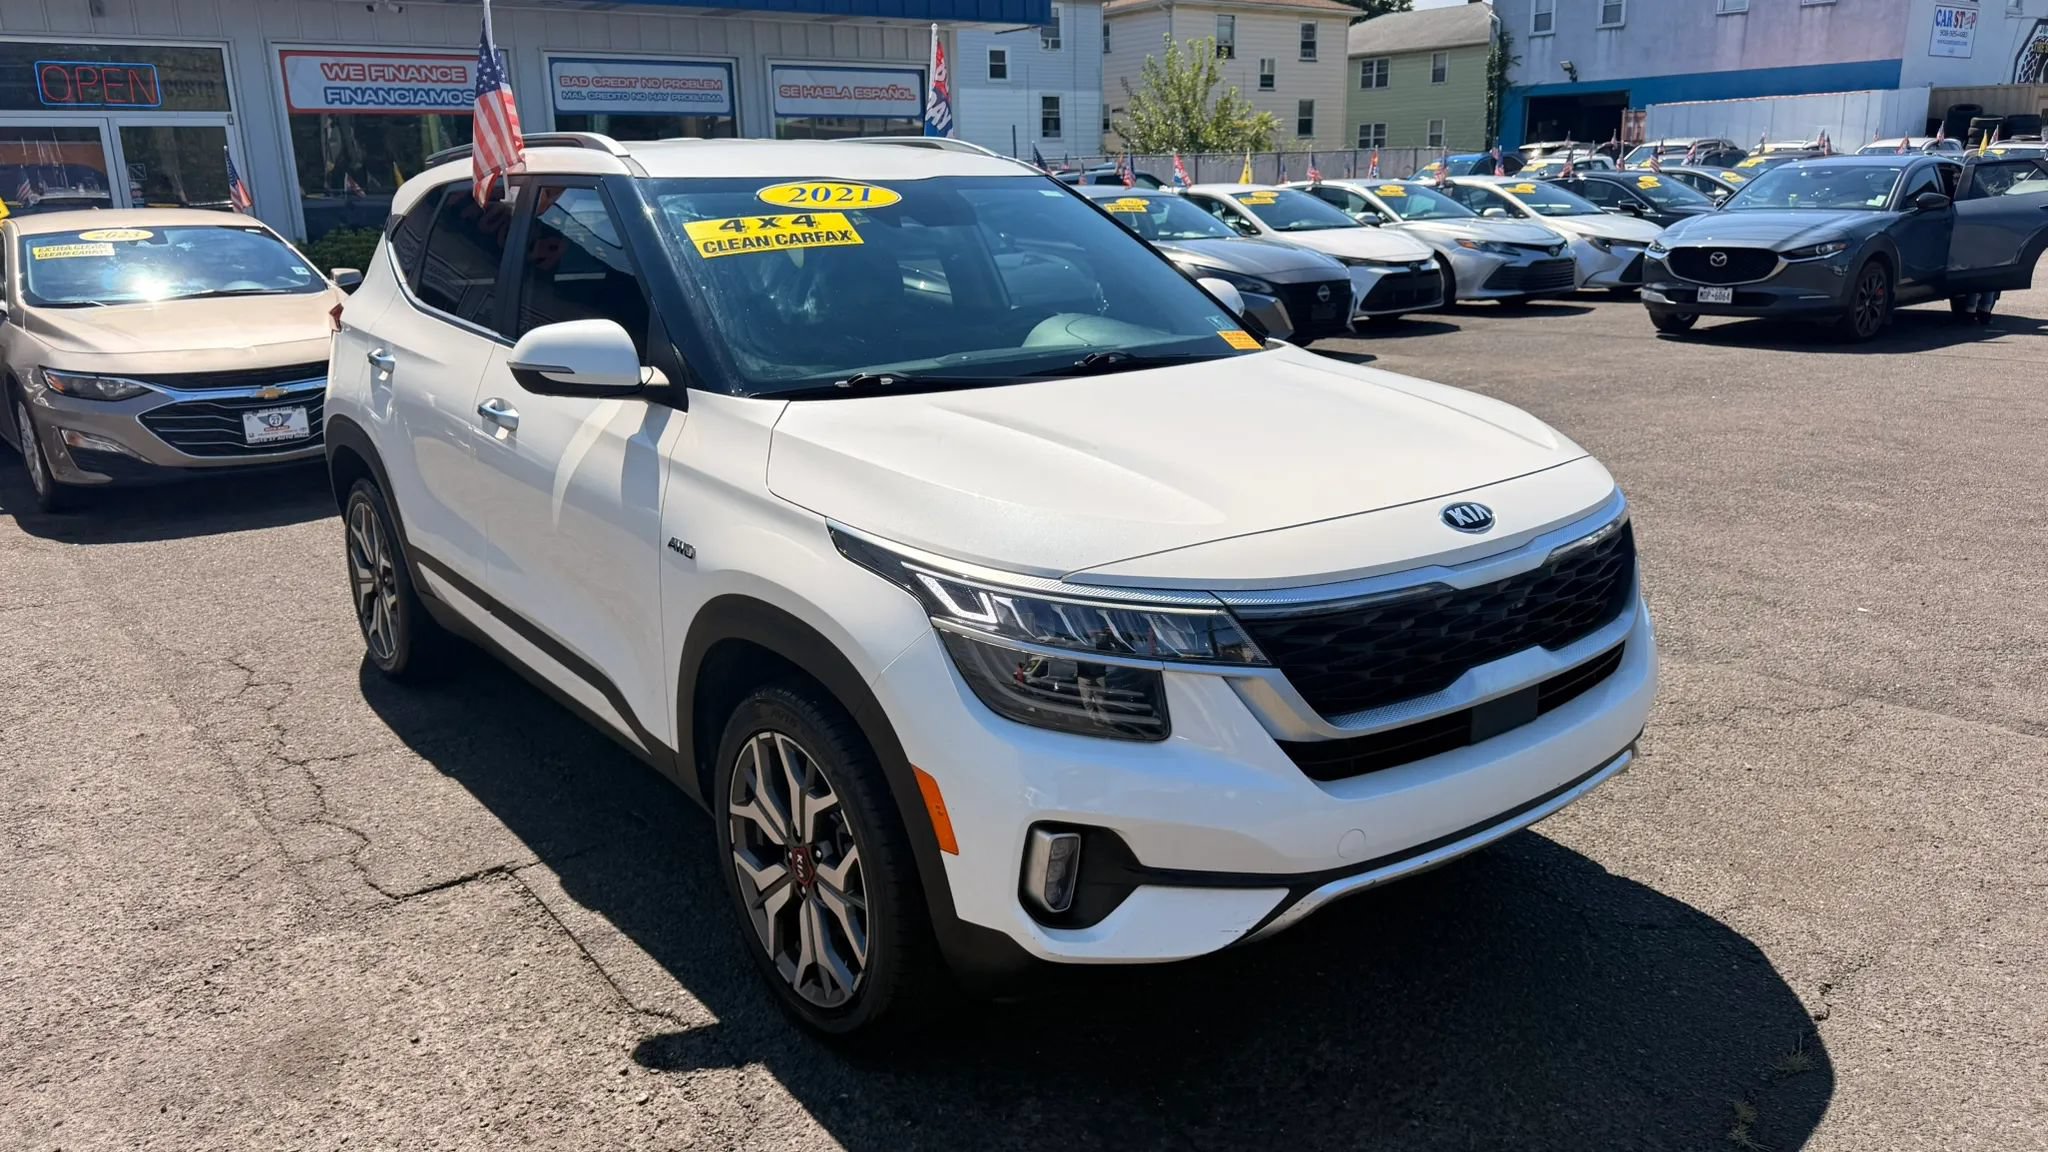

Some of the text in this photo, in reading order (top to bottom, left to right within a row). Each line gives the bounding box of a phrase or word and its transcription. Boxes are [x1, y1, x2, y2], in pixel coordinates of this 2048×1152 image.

[1935, 9, 1953, 27] CAR
[320, 63, 468, 83] WE FINANCE
[41, 65, 156, 104] OPEN
[559, 76, 723, 91] BAD CREDIT NO PROBLEM
[780, 84, 916, 100] SE HABLA ESPAÑOL
[324, 86, 475, 105] FINANCIAMOS
[561, 91, 724, 103] MAL CREDITO NO HAY PROBLEMA
[788, 186, 872, 203] 2021
[719, 218, 748, 233] 4
[791, 214, 817, 228] 4
[702, 228, 854, 255] CLEAN CARFAX
[1446, 503, 1492, 526] KIA
[668, 536, 697, 560] AWD
